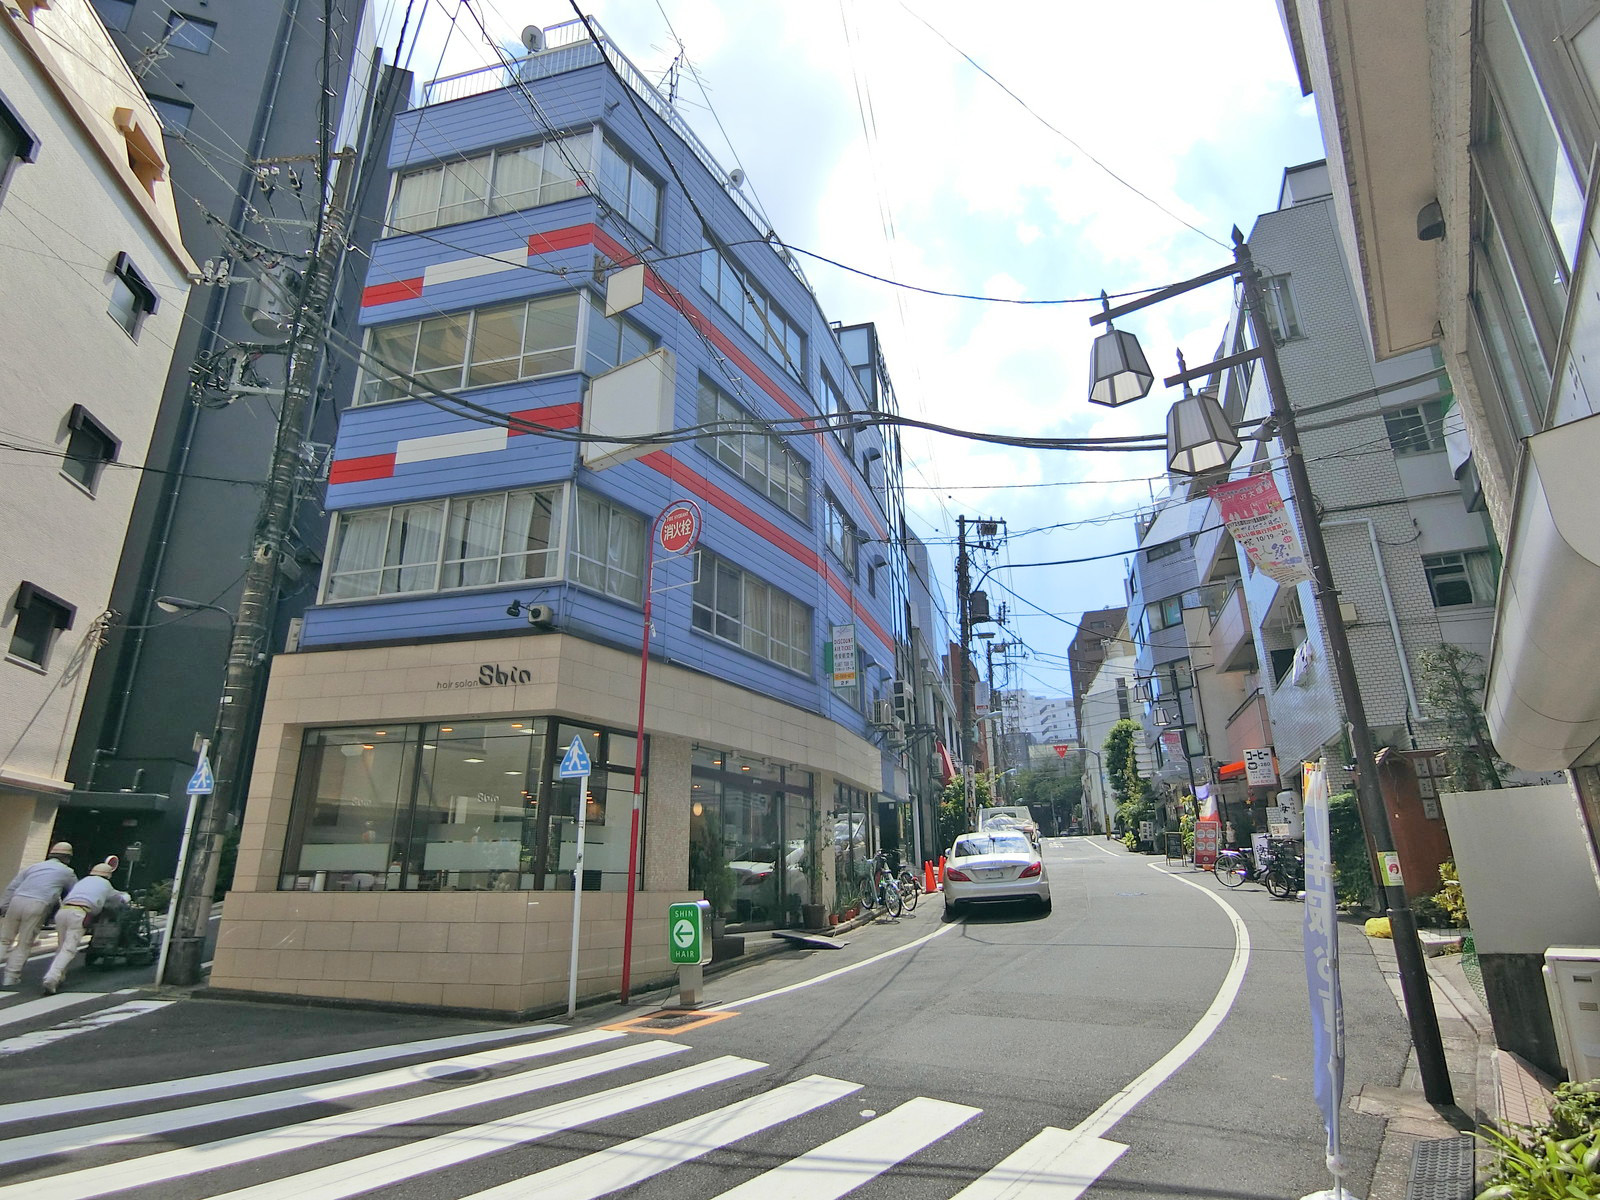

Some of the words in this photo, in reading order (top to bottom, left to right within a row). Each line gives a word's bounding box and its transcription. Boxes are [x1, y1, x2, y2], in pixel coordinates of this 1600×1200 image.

[663, 518, 692, 541] 消火栓
[436, 680, 453, 689] hair
[454, 679, 479, 688] salon
[478, 663, 531, 686] Shin
[1246, 750, 1269, 760] コーヒー
[674, 909, 694, 918] SHIN
[675, 950, 695, 958] HAIR
